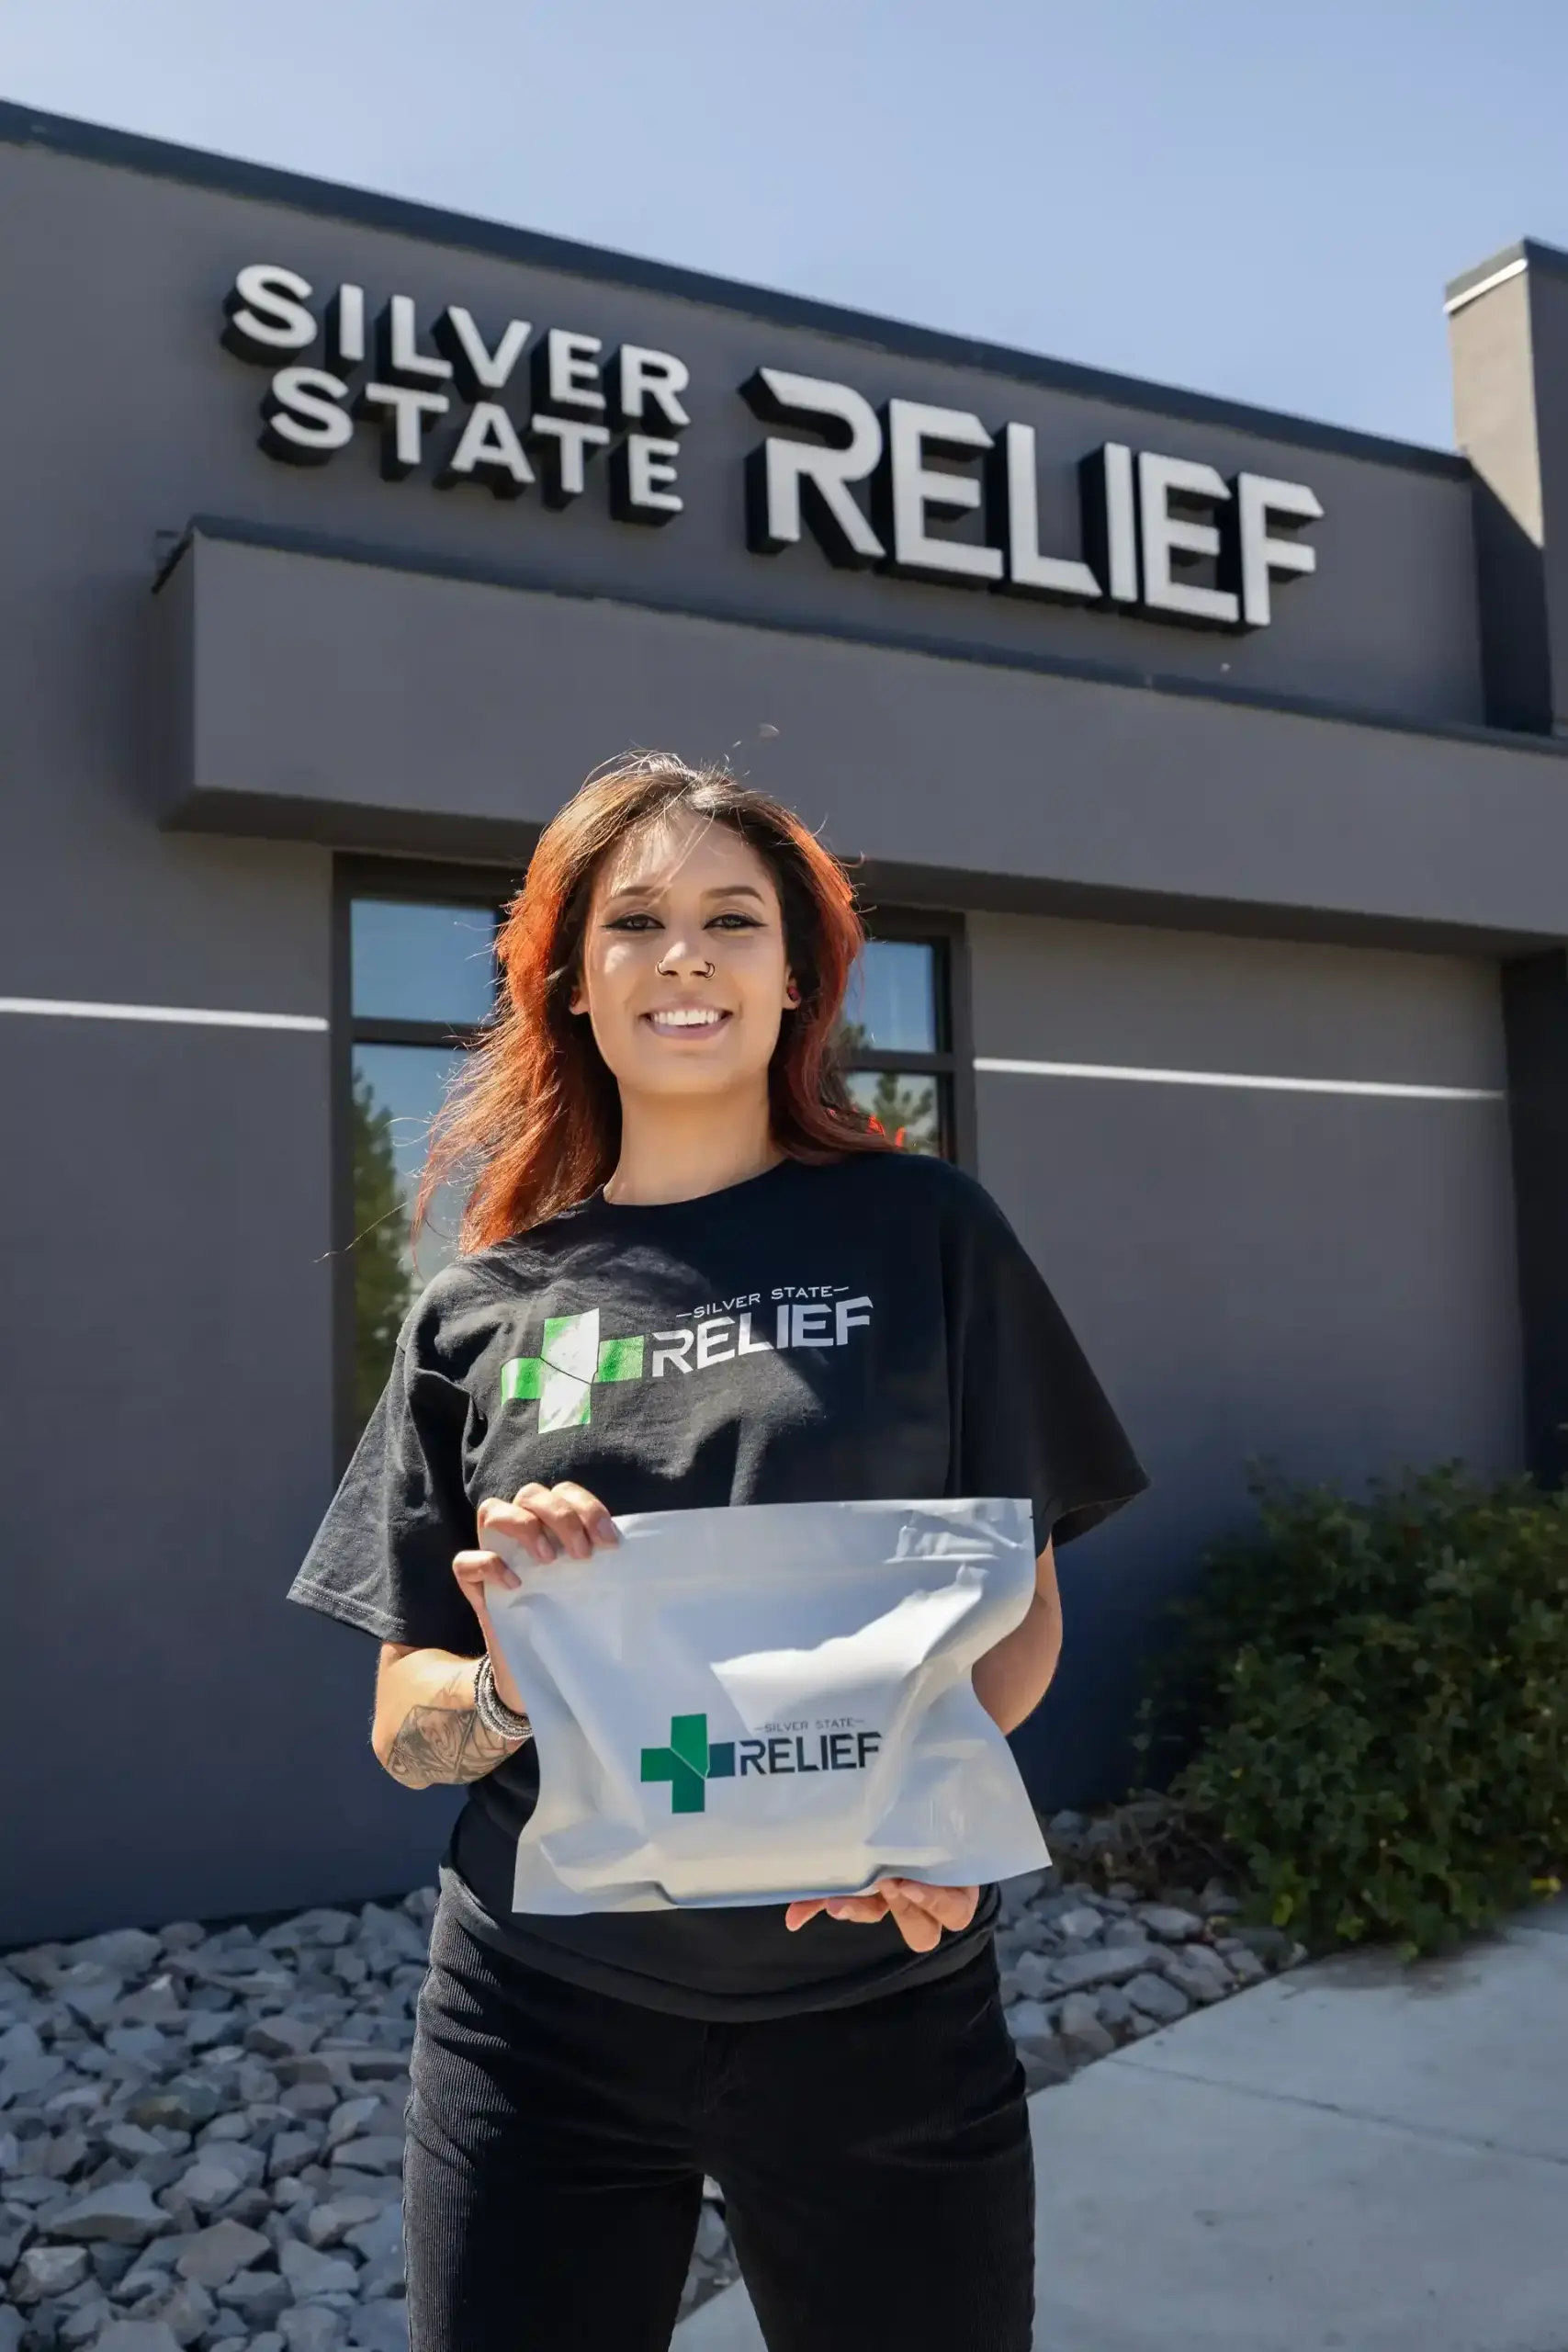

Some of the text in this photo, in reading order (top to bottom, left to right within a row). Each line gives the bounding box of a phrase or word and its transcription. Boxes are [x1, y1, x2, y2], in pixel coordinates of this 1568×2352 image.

[232, 264, 690, 425] SILVER
[270, 367, 683, 512] STATE
[760, 368, 1325, 627] RELIEF
[651, 1295, 874, 1378] RELIEF
[693, 1285, 833, 1319] SILVER STATE
[739, 1731, 882, 1776] RELIEF
[764, 1717, 855, 1733] SILVER STATE
